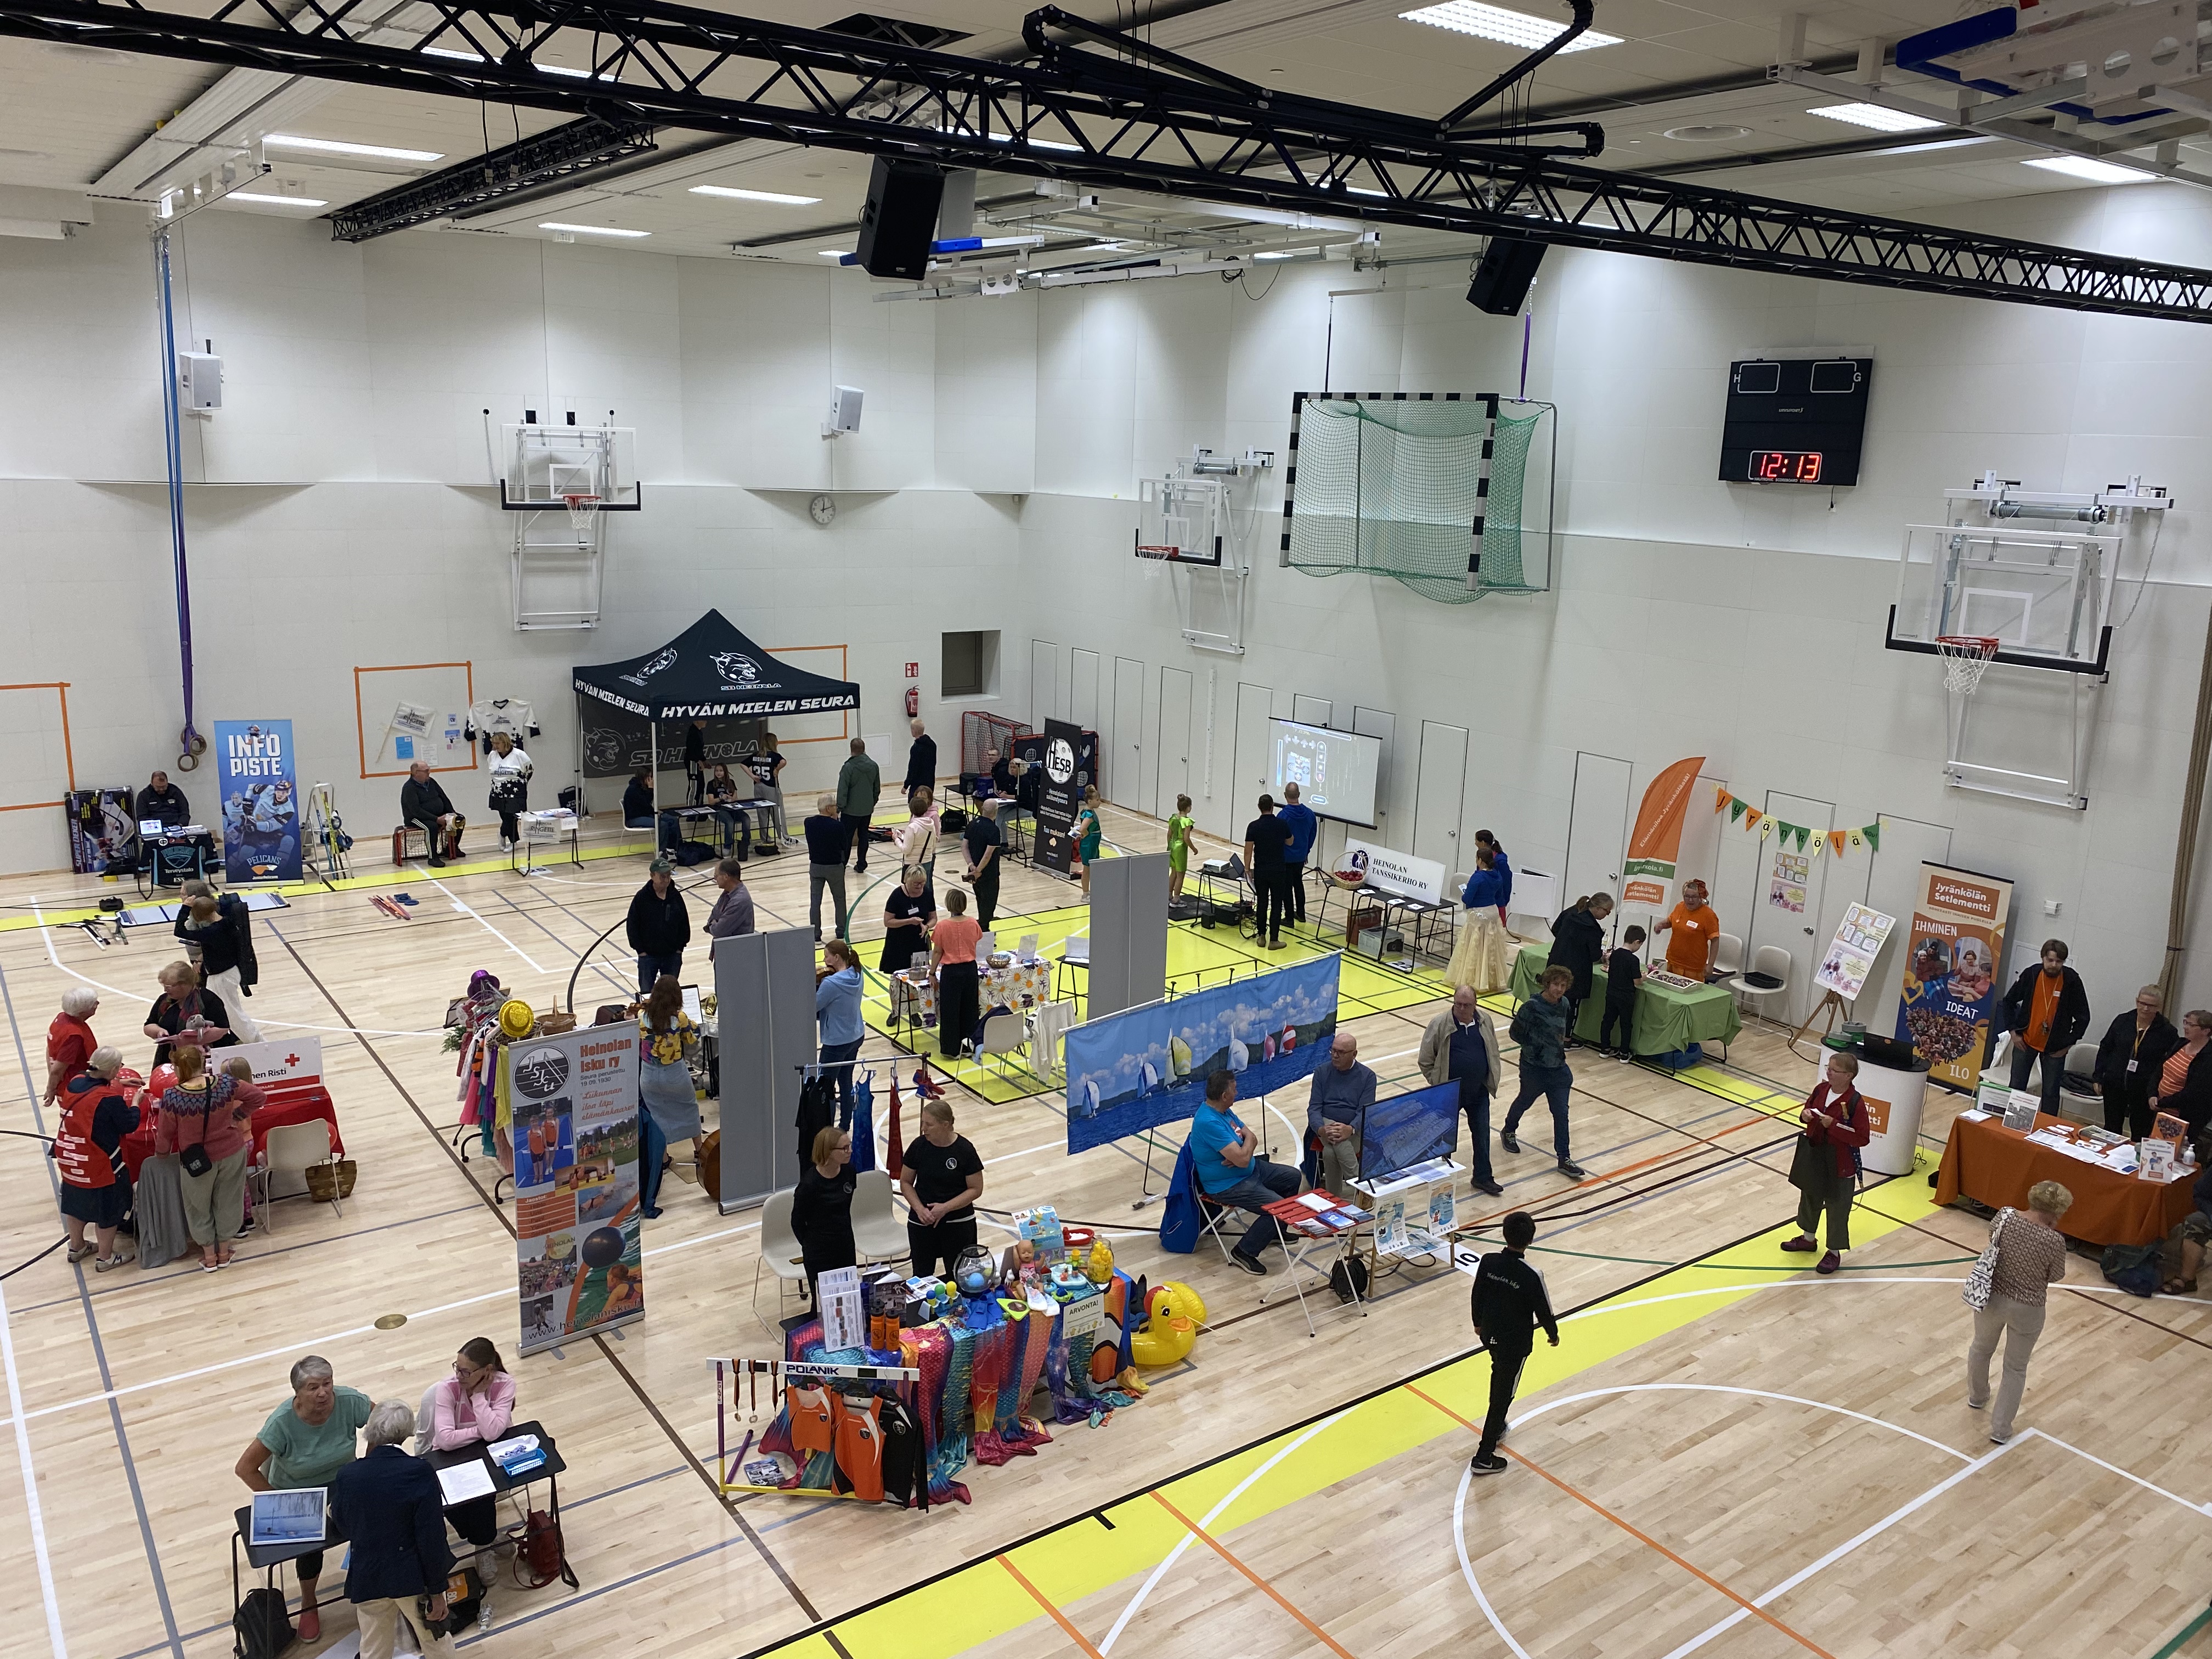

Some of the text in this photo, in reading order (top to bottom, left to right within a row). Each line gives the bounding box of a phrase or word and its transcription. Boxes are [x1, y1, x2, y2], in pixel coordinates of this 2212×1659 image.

[1733, 374, 1741, 383] H
[1853, 372, 1861, 382] G
[1760, 454, 1820, 479] 12:13
[575, 678, 598, 698] HYVÄN
[598, 688, 625, 708] MIELEN
[625, 700, 649, 717] SEURA
[661, 695, 854, 718] HYVÄN MIELEN SEURA
[228, 734, 280, 758] INFO
[1048, 736, 1071, 774] HESB
[230, 757, 283, 777] PISTE
[1639, 773, 1691, 848] Elämäniloa Jyränkölästä!
[246, 855, 281, 866] PELICANS
[1373, 858, 1408, 874] HEINOLAN
[1372, 867, 1429, 890] TANSSIKERHO RY
[1935, 882, 1987, 902] Jyränkölän
[1934, 892, 1991, 913] Setlementti
[1915, 920, 1957, 936] IHMINEN
[1945, 1001, 1979, 1019] IDEAT
[580, 1038, 632, 1058] Heinolan
[268, 1068, 287, 1077] Risti
[580, 1056, 620, 1073] Isku ry
[598, 1068, 625, 1078] perustettu
[1950, 1064, 1970, 1080] ILO
[580, 1076, 611, 1087] 19.09.1930
[582, 1099, 614, 1111] iloa läpi
[1454, 1252, 1480, 1267] 10
[1069, 1300, 1099, 1316] ARVONTA!
[528, 1297, 641, 1340] www.heinolanisku.fi
[786, 1364, 840, 1376] POLANIK
